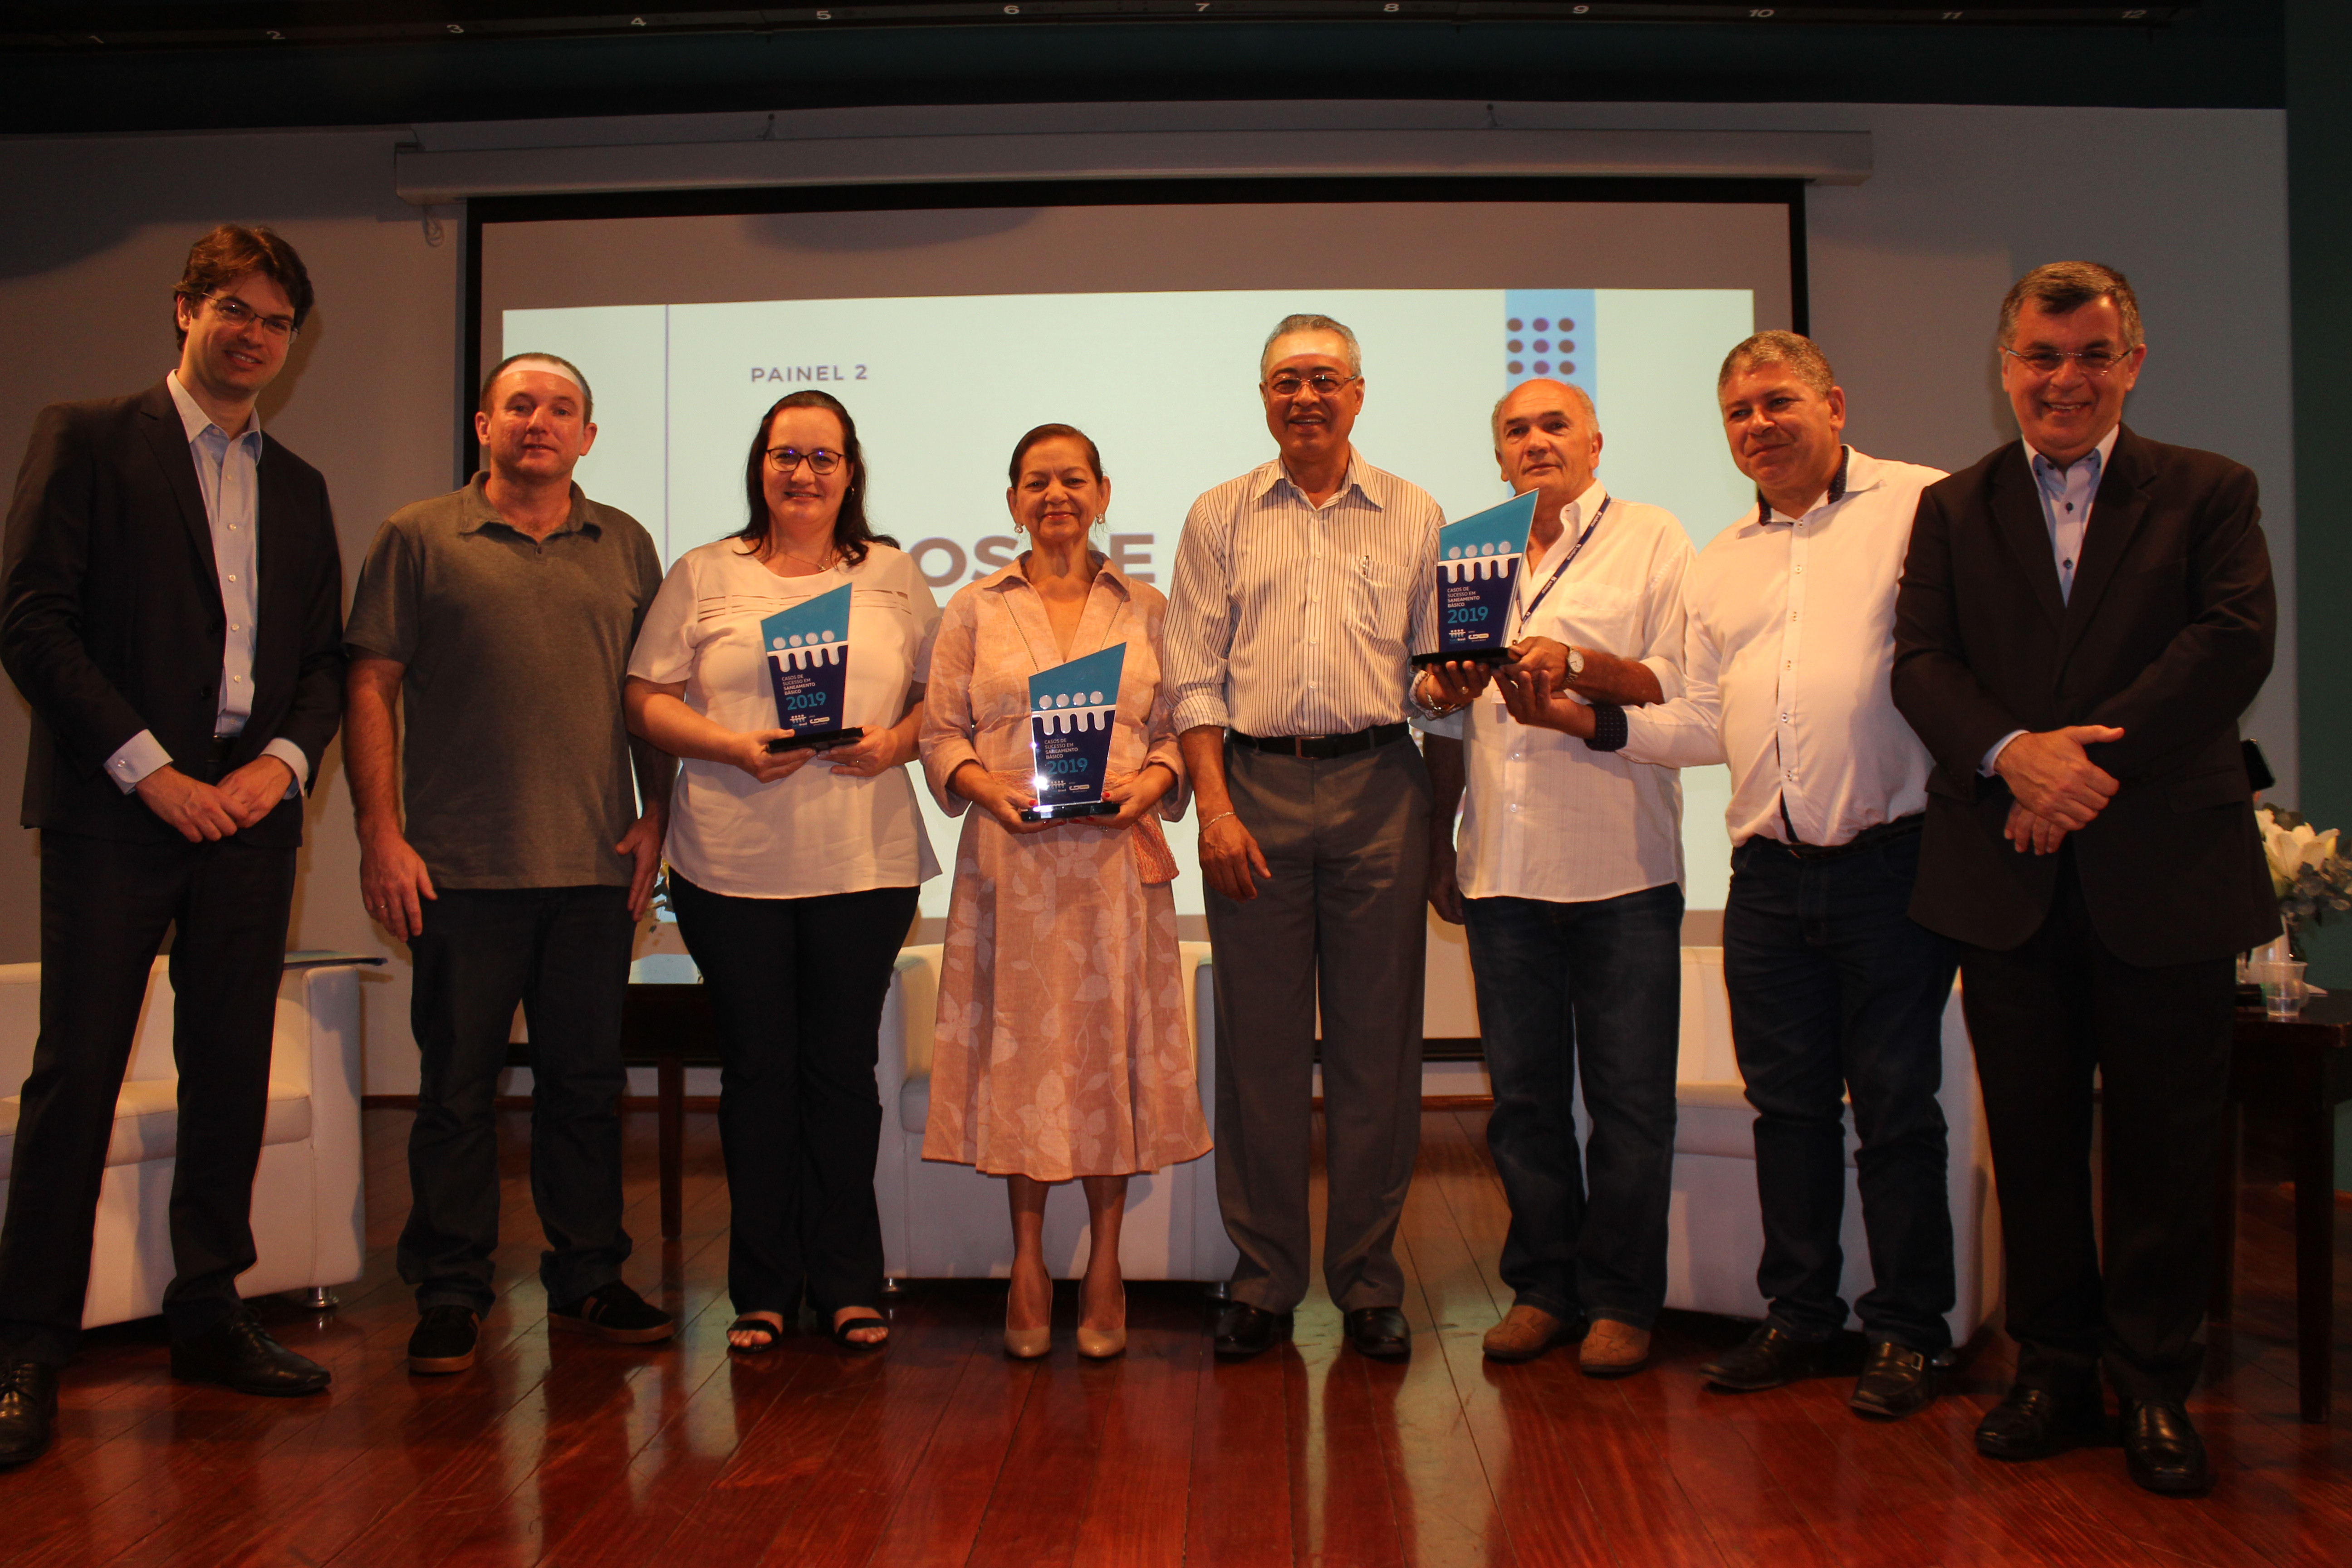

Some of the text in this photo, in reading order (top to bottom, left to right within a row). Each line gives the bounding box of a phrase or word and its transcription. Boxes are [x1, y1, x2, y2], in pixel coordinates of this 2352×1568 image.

[1003, 5, 1020, 15] 6
[1196, 3, 1210, 11] 7
[1383, 3, 1399, 12] 8
[1573, 5, 1589, 14] 9
[816, 10, 832, 20] 5
[1749, 9, 1774, 17] 10
[631, 17, 647, 26] 4
[447, 24, 464, 33] 3
[267, 31, 285, 39] 2
[752, 364, 867, 382] PAINEL 2
[908, 533, 1155, 588] OS E
[1448, 606, 1488, 624] 2019
[786, 692, 826, 710] 2019
[1047, 758, 1088, 775] 2019
